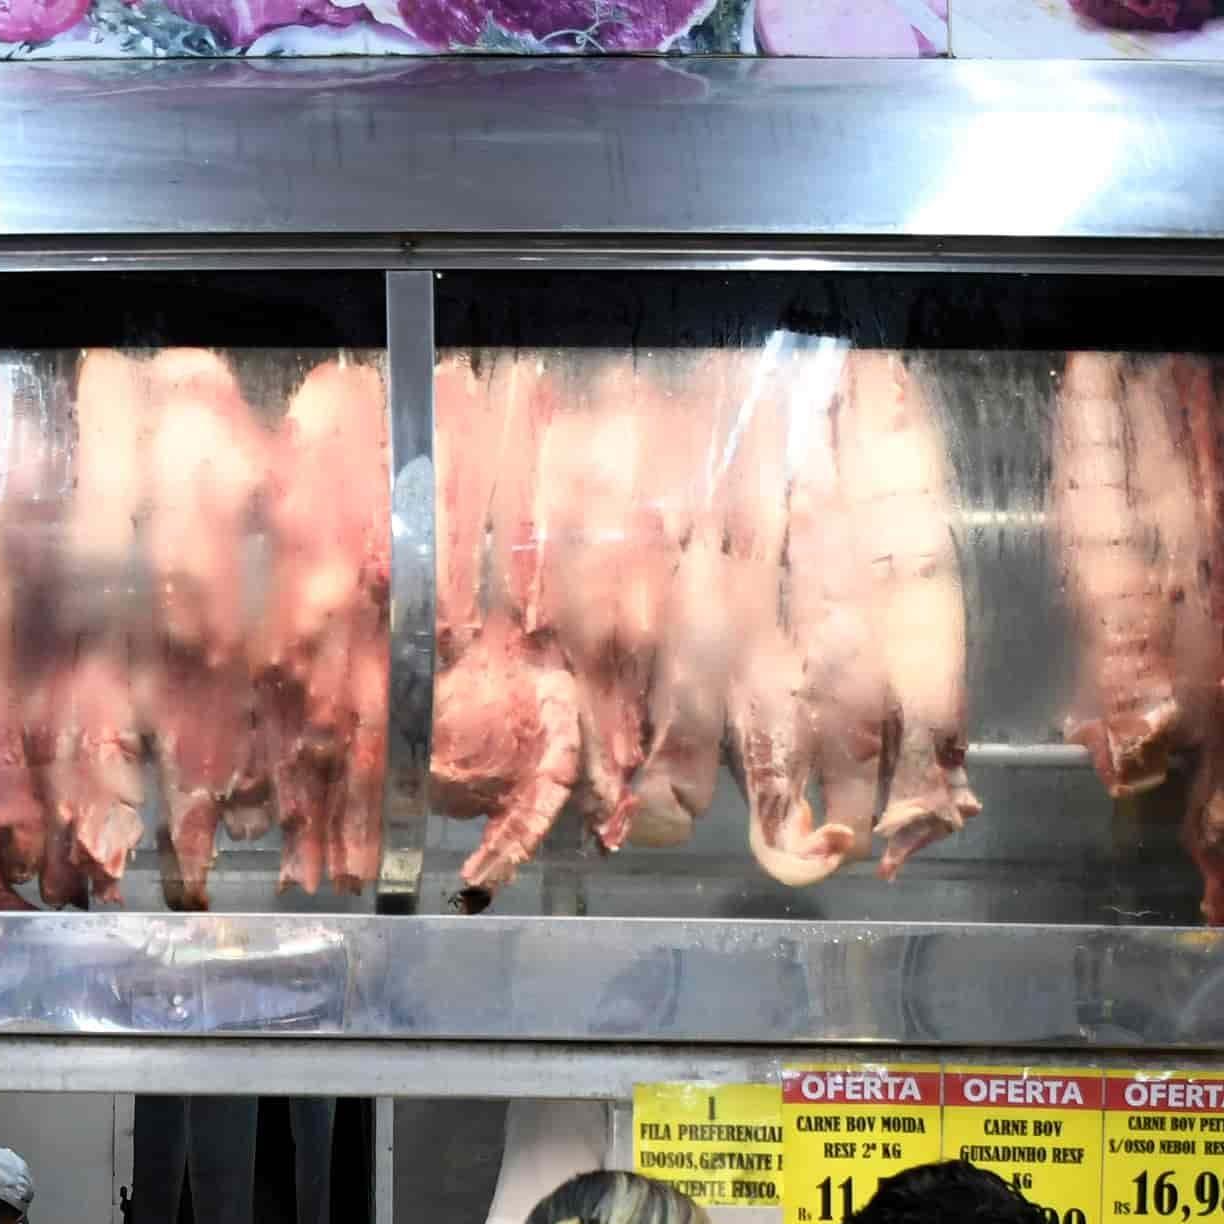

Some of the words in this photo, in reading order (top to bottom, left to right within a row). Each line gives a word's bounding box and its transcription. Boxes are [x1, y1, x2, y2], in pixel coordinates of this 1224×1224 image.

[801, 1075, 922, 1101] OFERTA
[963, 1078, 1084, 1105] OFERTA
[1124, 1083, 1224, 1108] OFERT
[640, 1123, 672, 1140] FILA
[796, 1116, 841, 1132] CARNE
[846, 1116, 876, 1132] BOV
[881, 1117, 926, 1134] MOIDA
[984, 1119, 1028, 1136] CARNE
[1033, 1120, 1063, 1136] BOV
[1128, 1116, 1166, 1131] CARNE
[1171, 1117, 1196, 1131] BOV
[824, 1142, 857, 1158] RESF
[882, 1142, 901, 1159] KG
[960, 1145, 1046, 1162] GUISADINHO
[1052, 1148, 1085, 1164] RESF
[1109, 1138, 1155, 1154] S/OSSO
[1159, 1140, 1195, 1154] NEBOI
[1013, 1173, 1033, 1189] KG
[1132, 1169, 1224, 1222] 16,9
